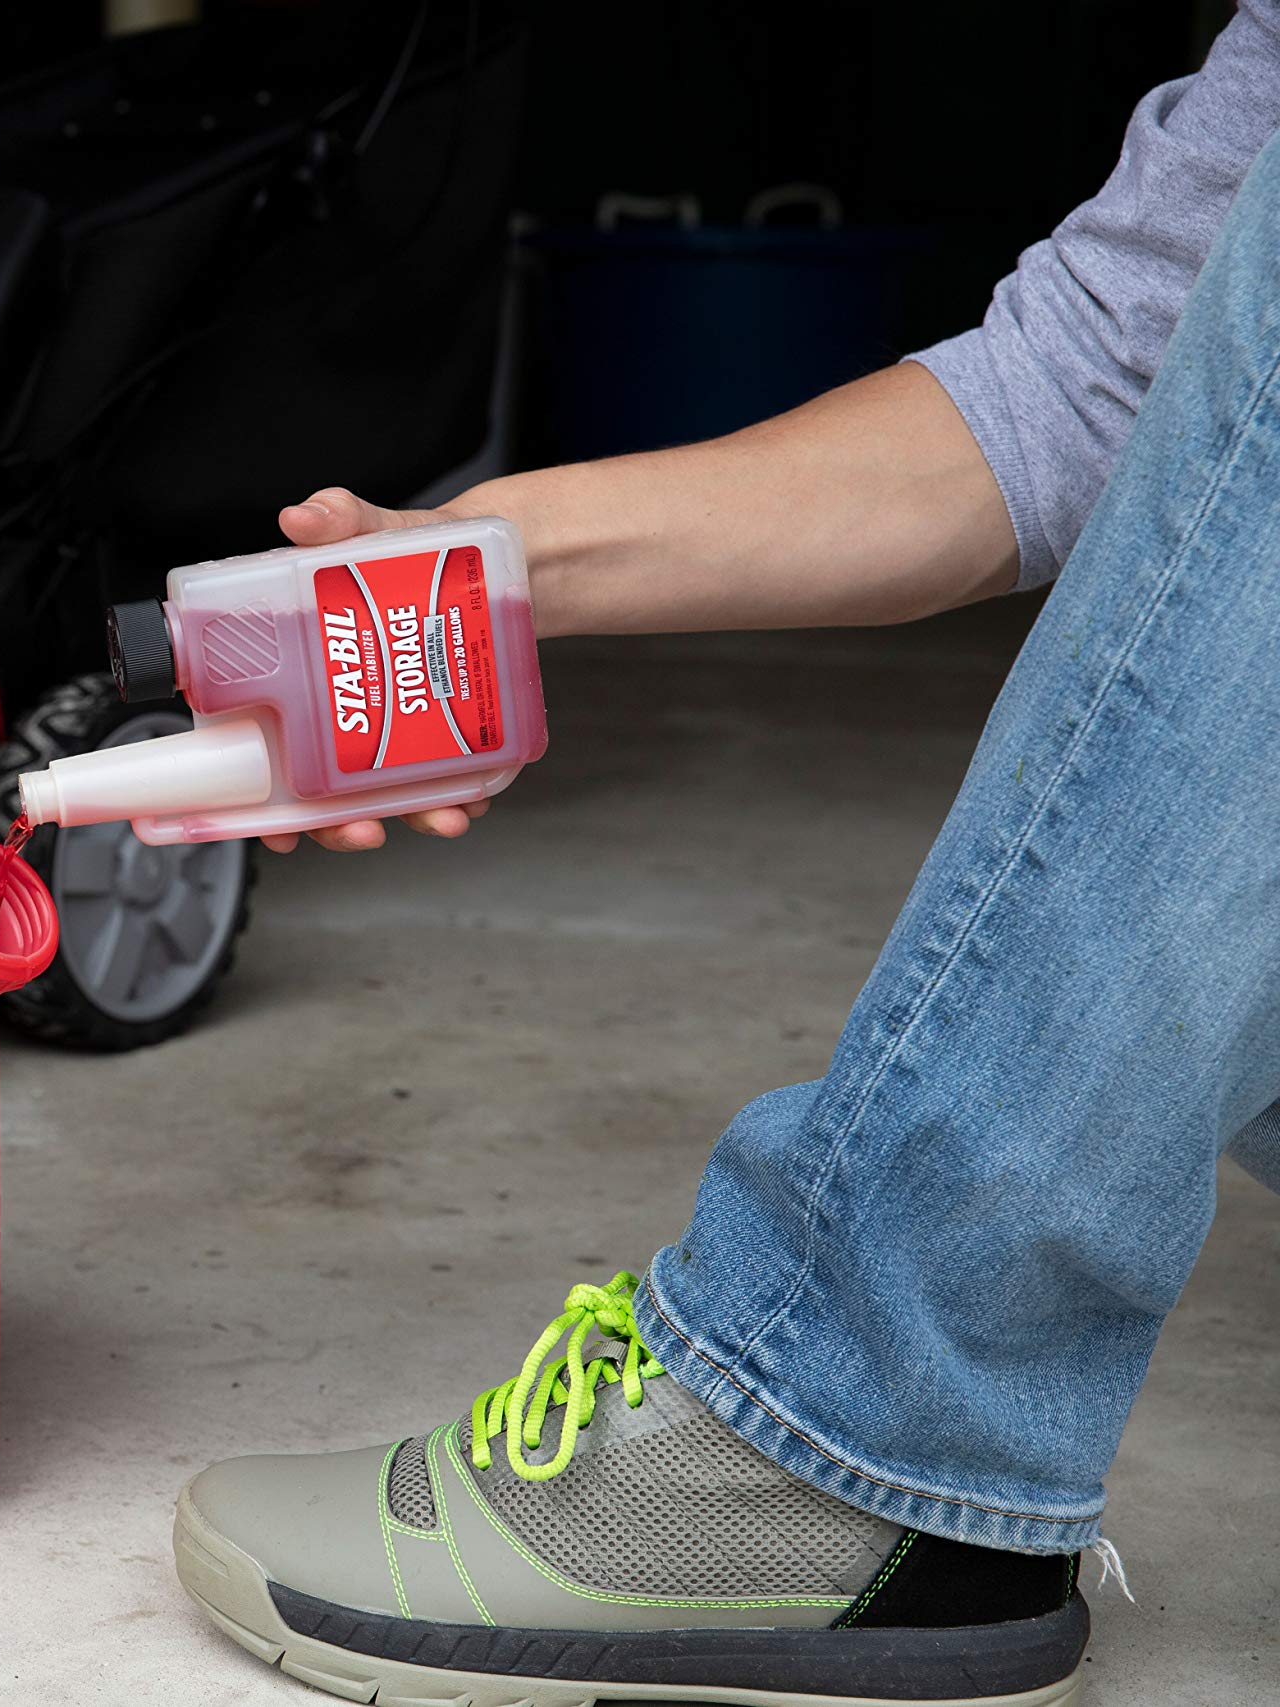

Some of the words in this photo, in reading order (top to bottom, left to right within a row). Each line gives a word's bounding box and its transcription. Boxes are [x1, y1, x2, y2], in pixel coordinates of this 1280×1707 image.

[465, 553, 477, 567] mL)
[467, 569, 479, 584] (236
[470, 596, 481, 604] FL
[434, 619, 444, 636] FUELS
[449, 607, 463, 645] GALLONS
[426, 633, 434, 644] ALL
[363, 630, 378, 681] STABILIZER
[388, 606, 428, 715] STORAGE
[435, 638, 446, 665] BLENDED
[454, 646, 464, 658] 20
[324, 607, 369, 737] STA-BIL
[428, 653, 439, 682] EFFECTIVE
[457, 659, 466, 667] TO
[459, 668, 467, 677] UP
[440, 666, 451, 693] ETHANOL
[459, 678, 470, 700] TREATS
[369, 685, 381, 707] FUEL
[479, 725, 488, 746] DANGER:
